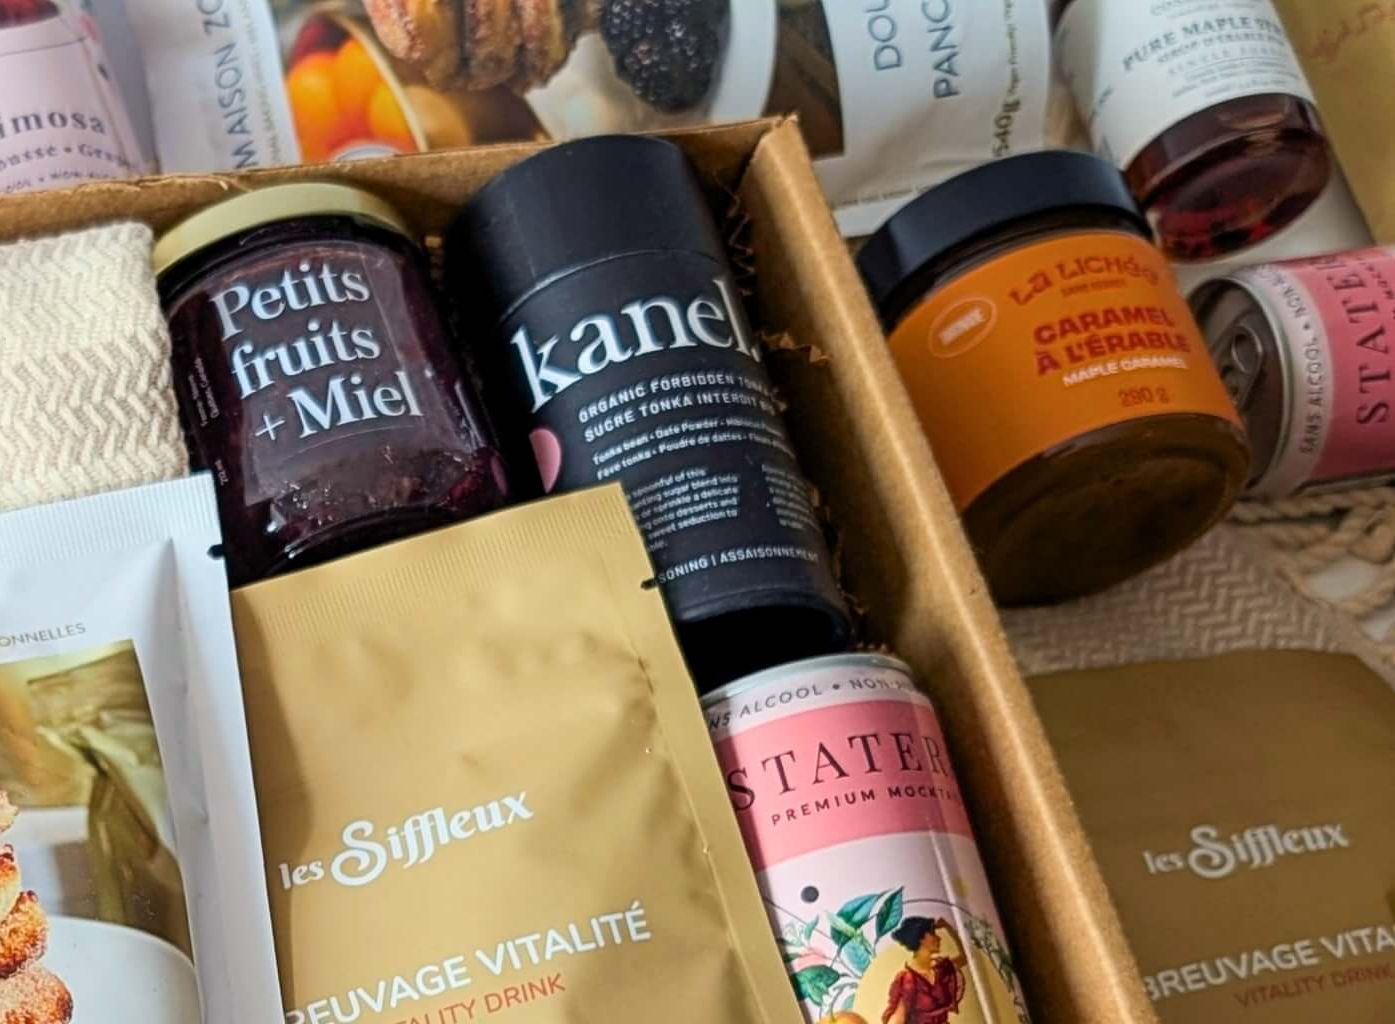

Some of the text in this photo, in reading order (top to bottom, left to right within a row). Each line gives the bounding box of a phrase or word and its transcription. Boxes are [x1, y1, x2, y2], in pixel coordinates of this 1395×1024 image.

[214, 42, 258, 169] MAISON
[209, 261, 370, 342] Petits
[1034, 306, 1175, 344] CARAMEL
[231, 319, 381, 399] fruits
[1035, 331, 1190, 375] À L'ÉRABLE
[287, 370, 424, 438] Miel
[578, 373, 735, 424] ORGANIC FORBIDDEN
[584, 396, 694, 443] SUCRE TONKA
[739, 685, 823, 718] ALCOOL
[727, 732, 949, 812] STATER
[771, 789, 876, 826] PREMIUM
[278, 792, 534, 890] les Siffleux
[1143, 823, 1350, 878] les Siffleux
[476, 900, 651, 976] VITALITÉ
[484, 973, 567, 1014] DRINK
[1234, 964, 1394, 1007] VITALITY DRINK
